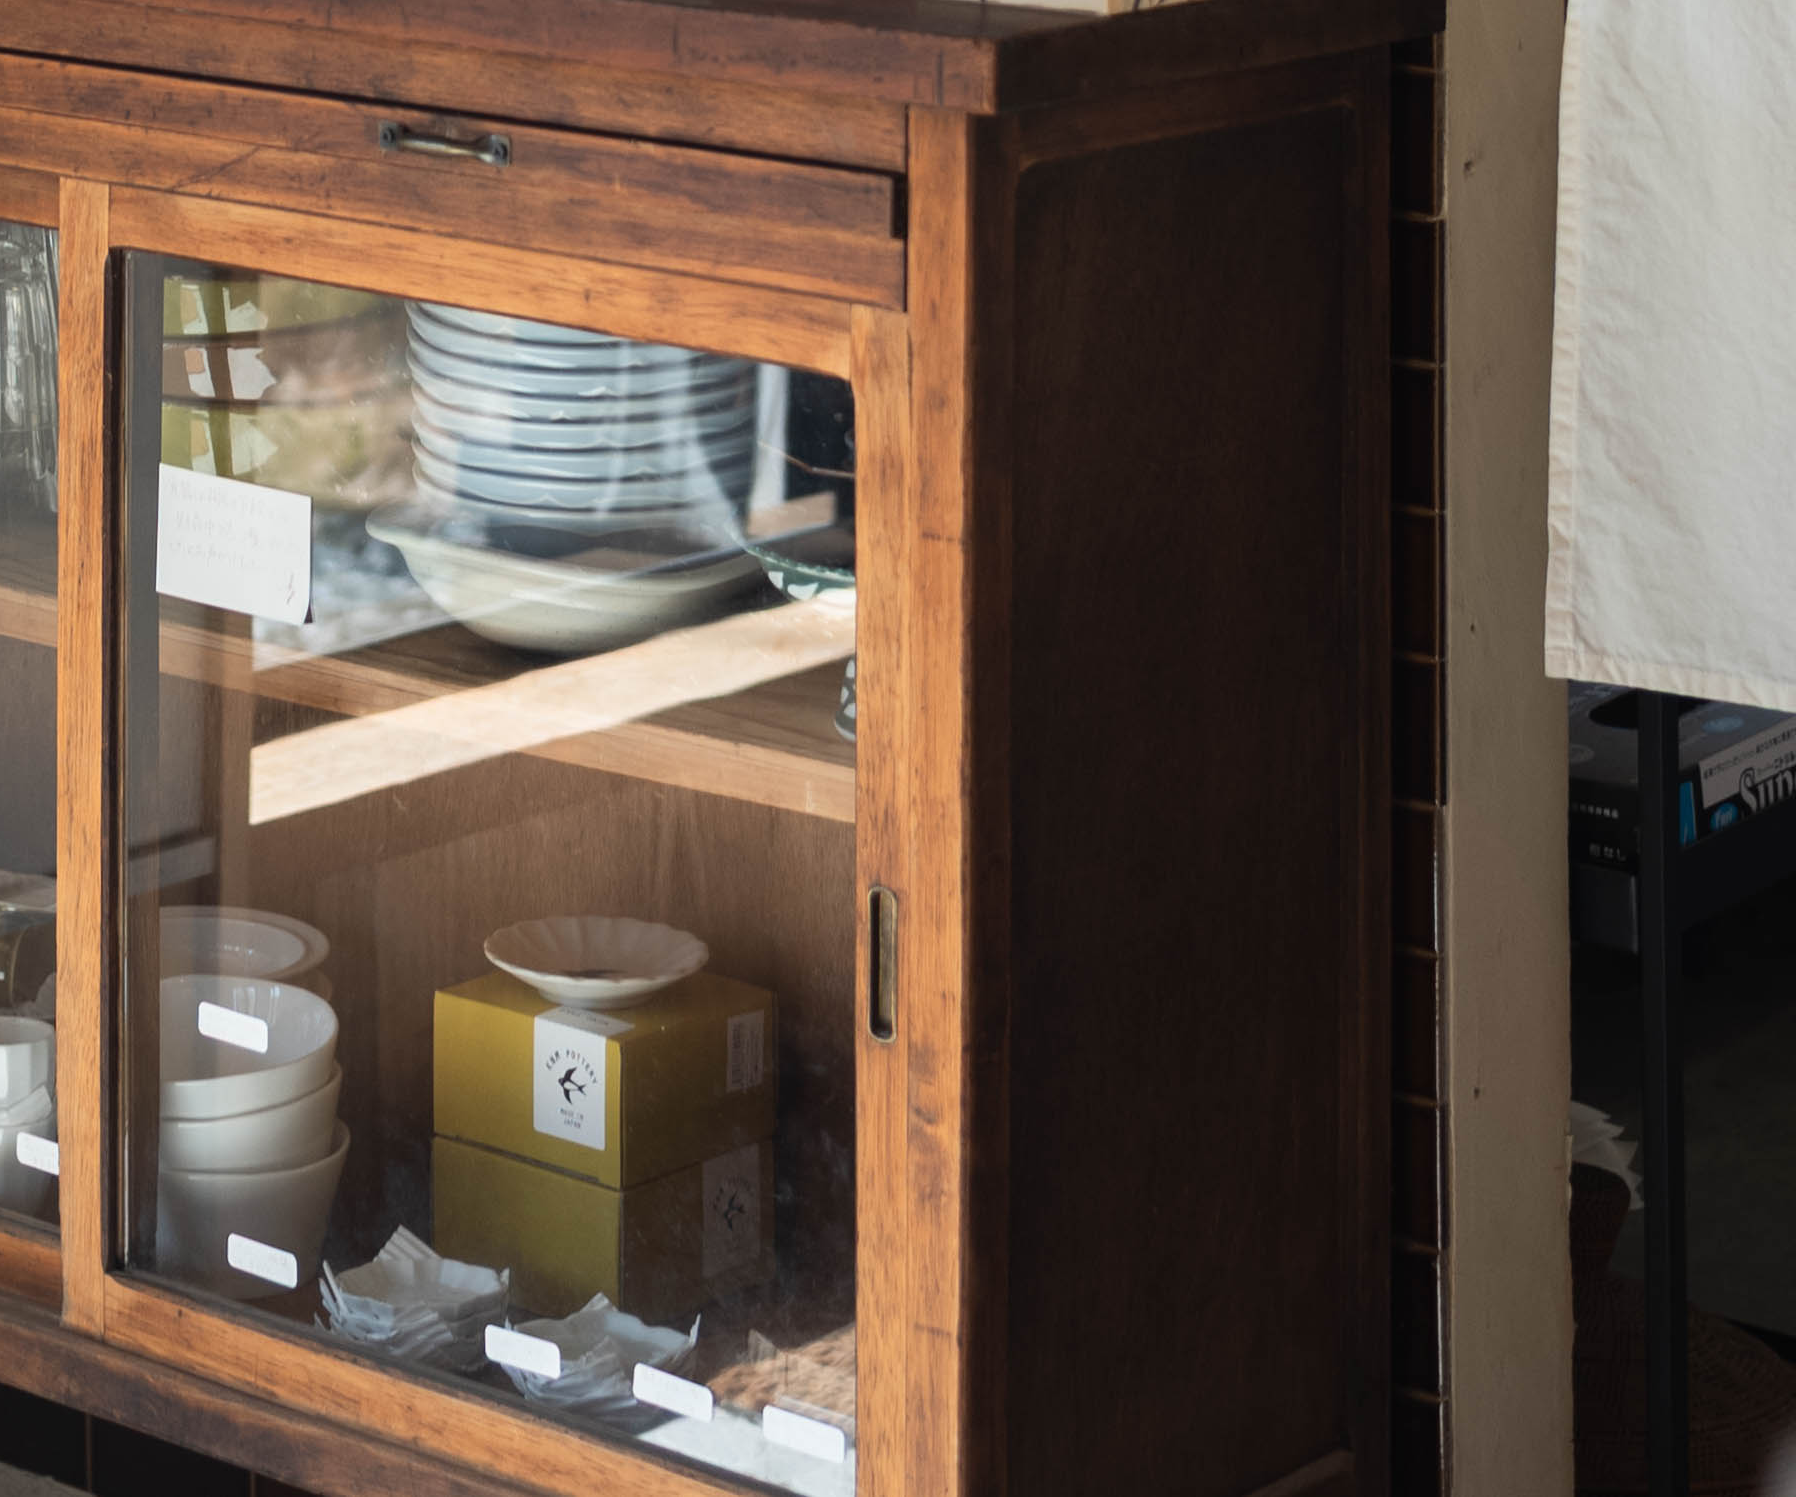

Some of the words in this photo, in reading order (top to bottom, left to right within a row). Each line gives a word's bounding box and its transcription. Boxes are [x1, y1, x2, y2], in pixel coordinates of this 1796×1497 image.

[565, 1048, 599, 1086] POTTERY
[559, 1108, 575, 1119] MADE
[563, 1118, 582, 1130] JAPAN
